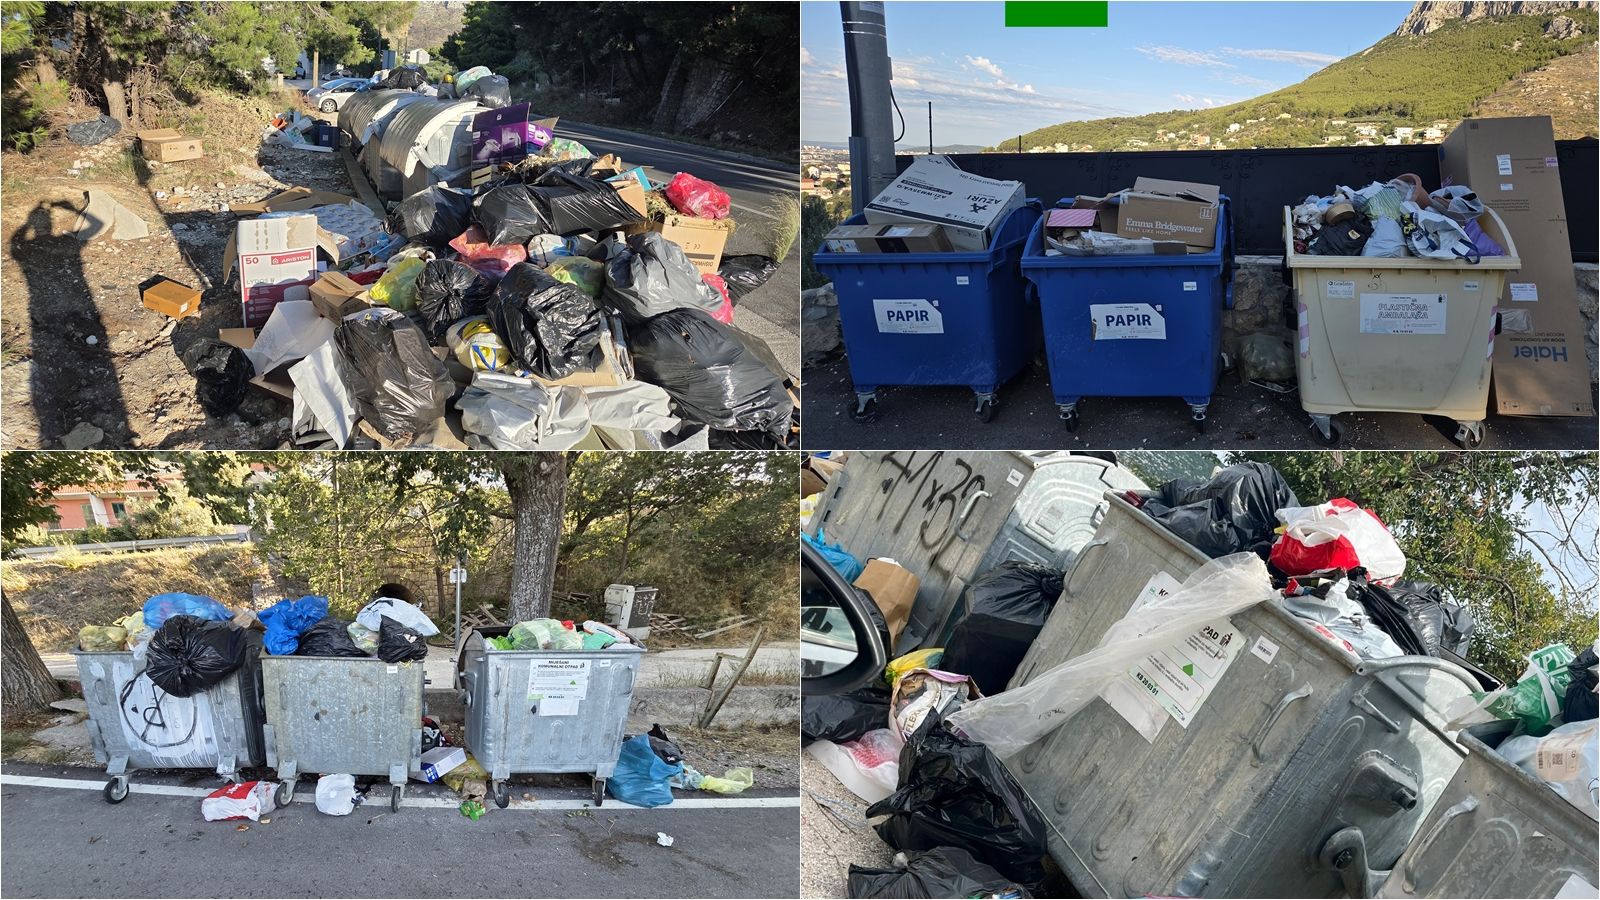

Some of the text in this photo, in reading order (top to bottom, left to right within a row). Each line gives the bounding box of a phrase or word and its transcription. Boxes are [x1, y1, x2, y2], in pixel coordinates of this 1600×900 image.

[967, 194, 1003, 206] AZURI
[1126, 217, 1204, 233] Emma Bridgewater
[245, 255, 310, 265] 50 ARISTON
[1378, 302, 1428, 312] PLASTIČNA
[887, 310, 929, 322] PAPIR
[1105, 314, 1152, 327] PAPIR
[1378, 310, 1428, 320] AMBALAŽA
[1514, 345, 1568, 362] Haier
[1136, 672, 1144, 681] KB
